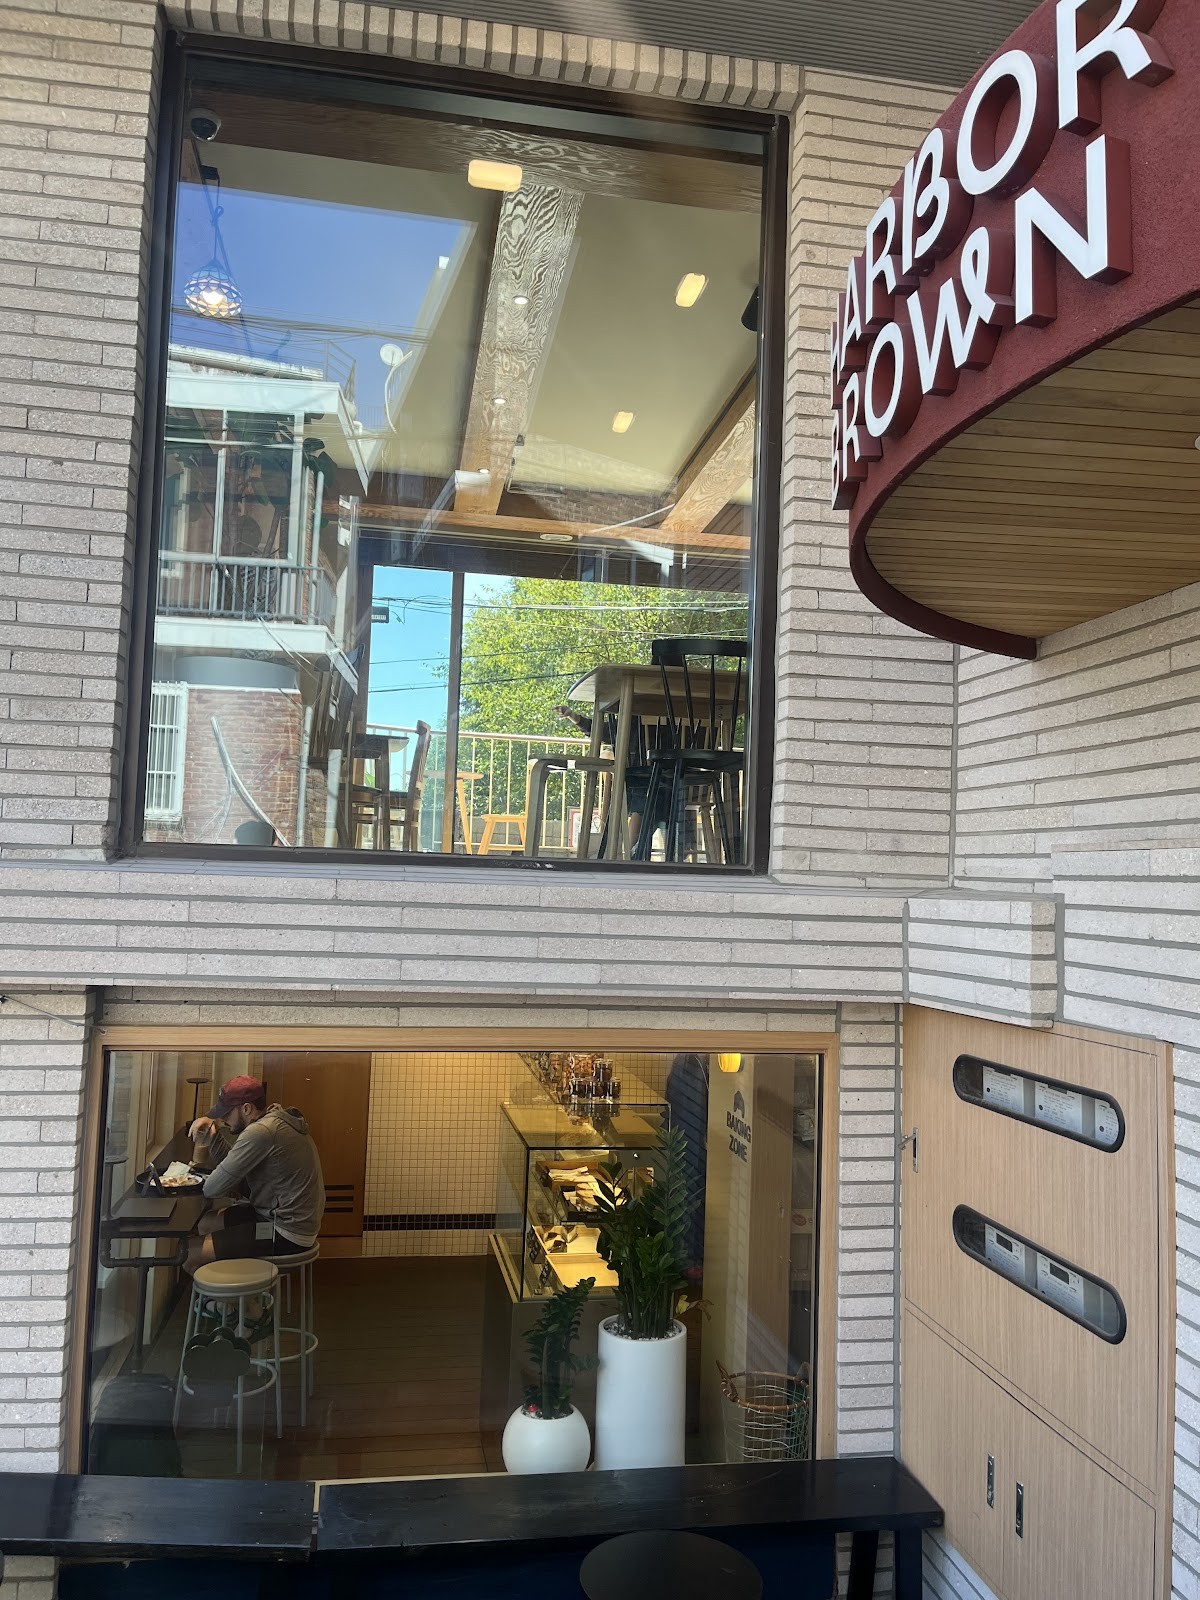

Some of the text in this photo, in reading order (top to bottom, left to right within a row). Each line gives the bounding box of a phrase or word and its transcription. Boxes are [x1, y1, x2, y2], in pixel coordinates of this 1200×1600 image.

[831, 0, 1153, 409] HARBOR
[832, 134, 1106, 510] BROWN
[727, 1111, 751, 1143] BAKING
[729, 1134, 748, 1163] ZONE
